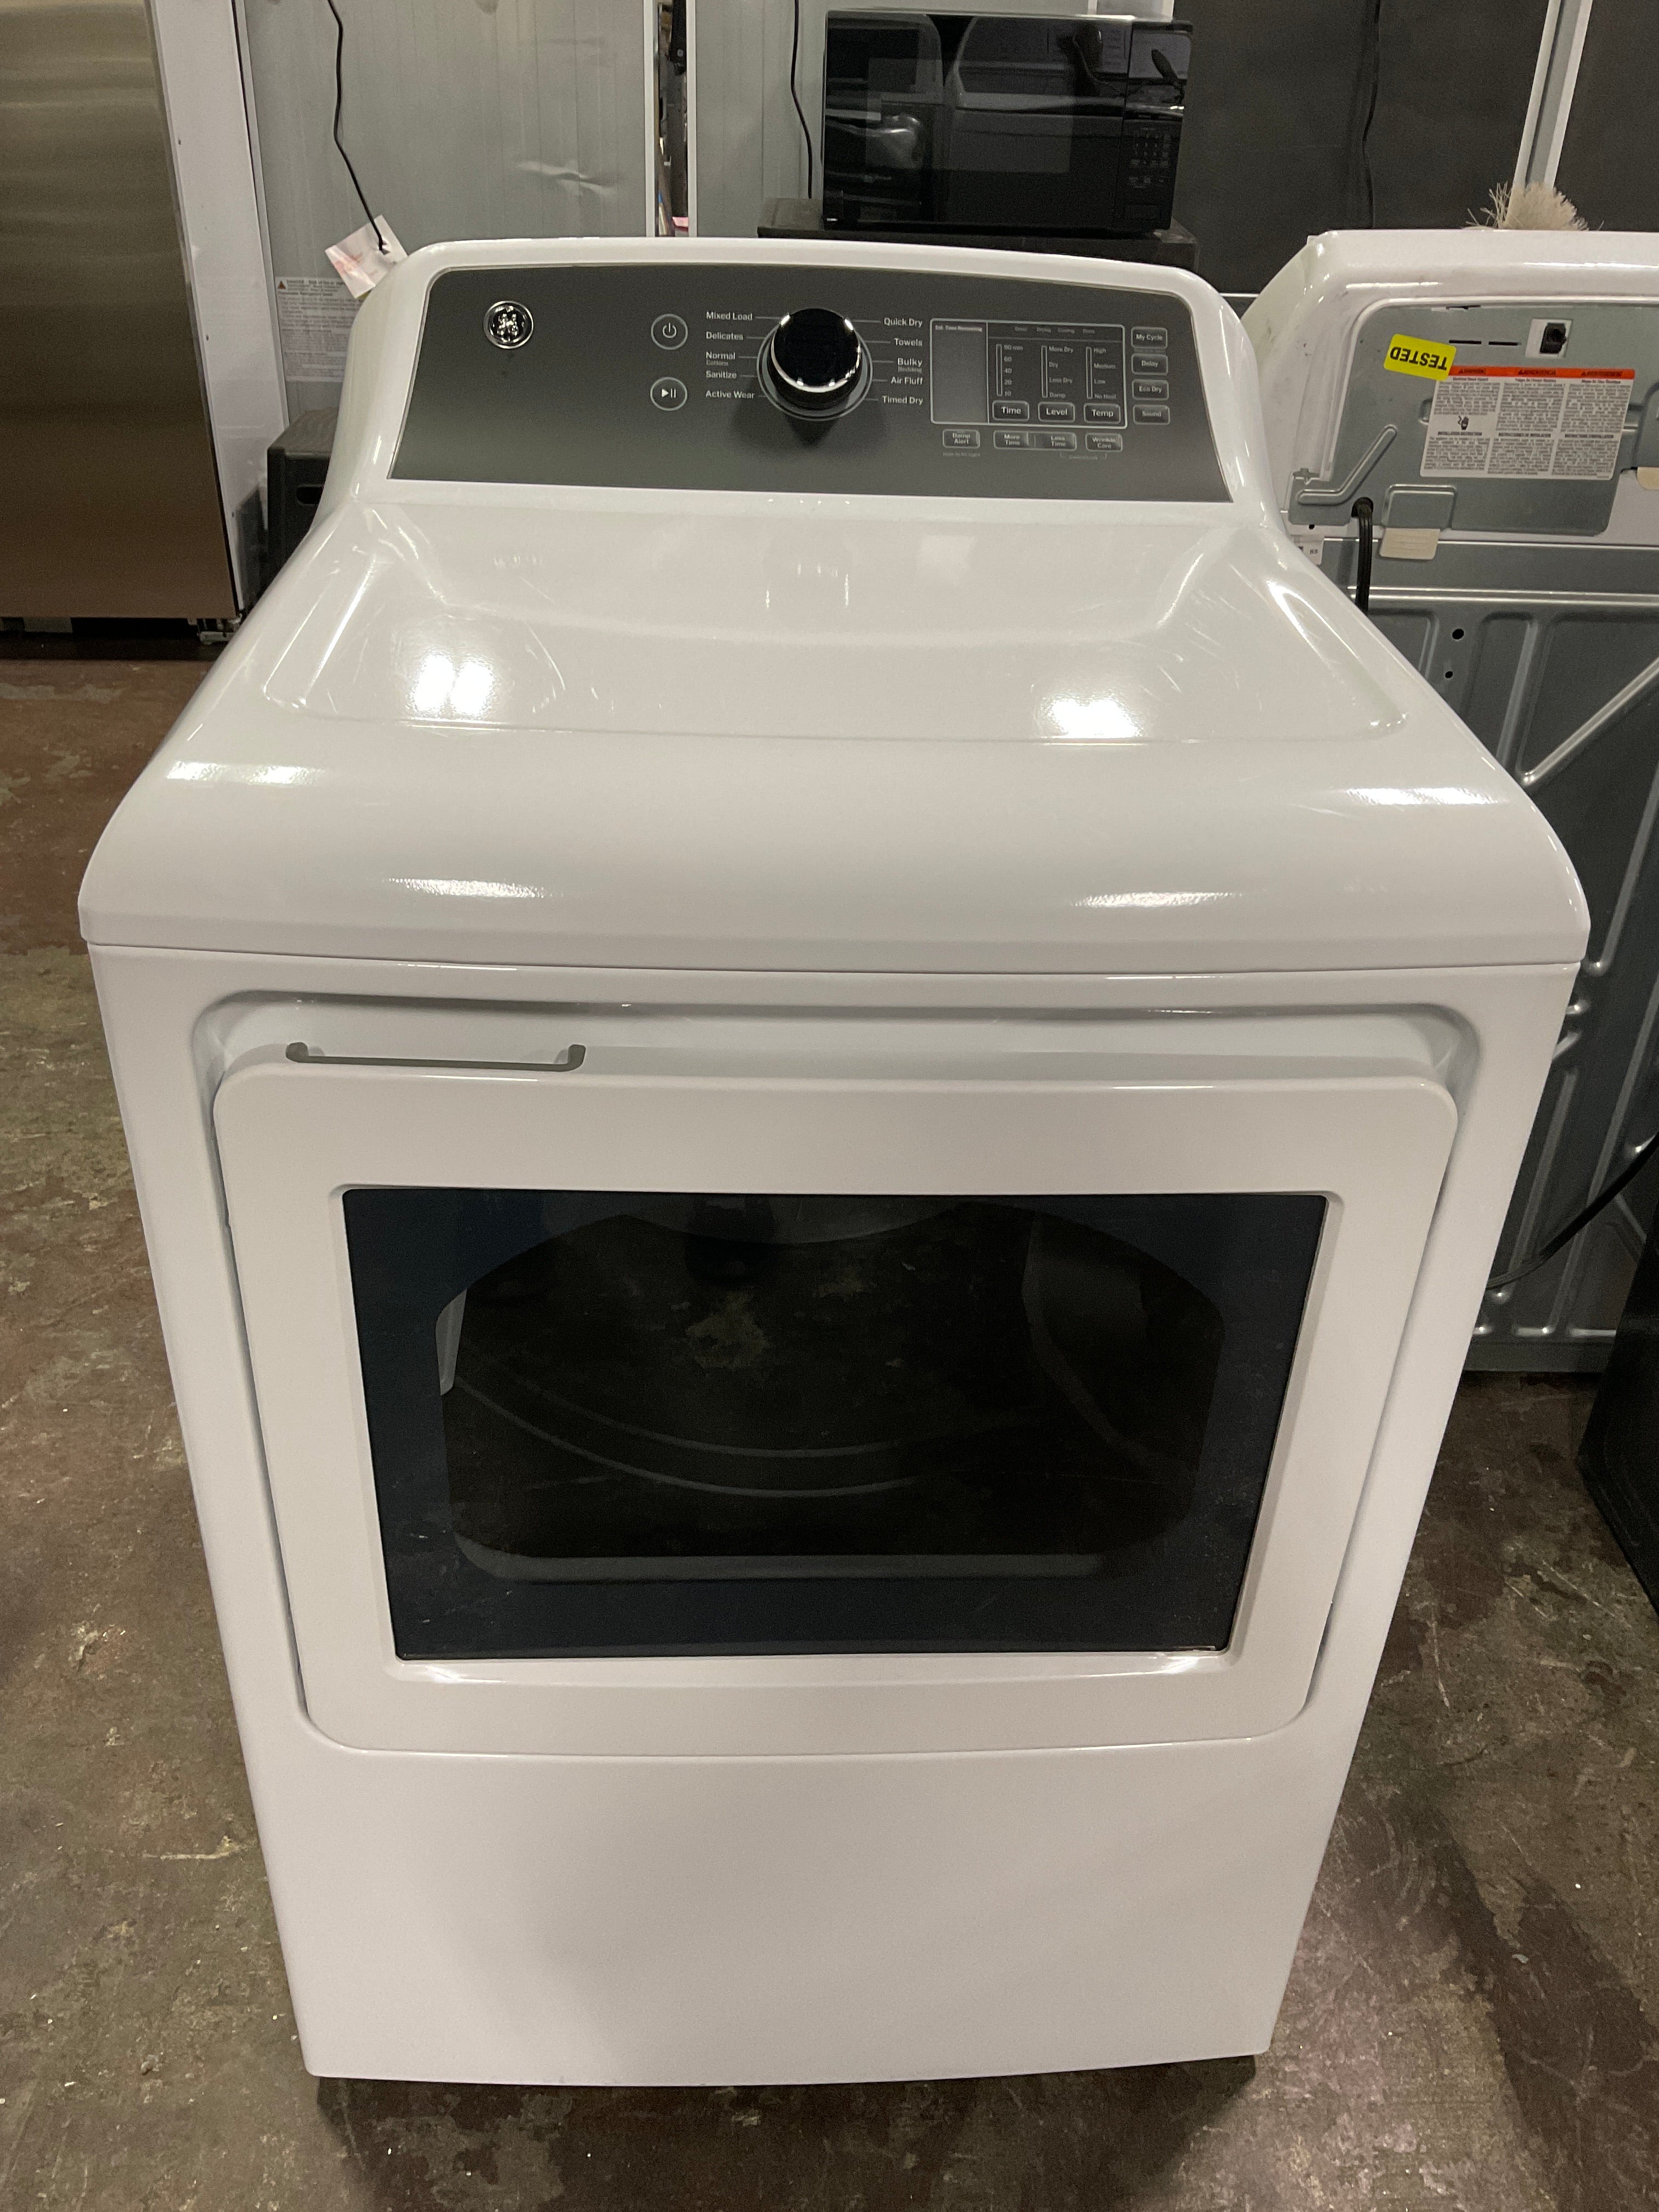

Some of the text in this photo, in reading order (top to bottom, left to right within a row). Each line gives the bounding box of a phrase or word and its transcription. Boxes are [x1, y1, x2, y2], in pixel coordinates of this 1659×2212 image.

[706, 311, 753, 321] Mixed Load
[884, 318, 923, 328] Quick Dry
[706, 331, 744, 341] Delicates
[1136, 334, 1145, 342] My
[894, 337, 923, 347] Towels
[706, 351, 736, 360] Normal
[1390, 346, 1447, 371] TESTED
[897, 358, 923, 367] Bulky
[1141, 360, 1158, 368] Delay
[706, 370, 737, 379] Sanitize
[706, 390, 755, 399] Active Wear
[882, 396, 923, 405] Timed Dry
[1001, 407, 1022, 415] Time
[1046, 408, 1068, 416] Level
[1092, 409, 1114, 417] Temp
